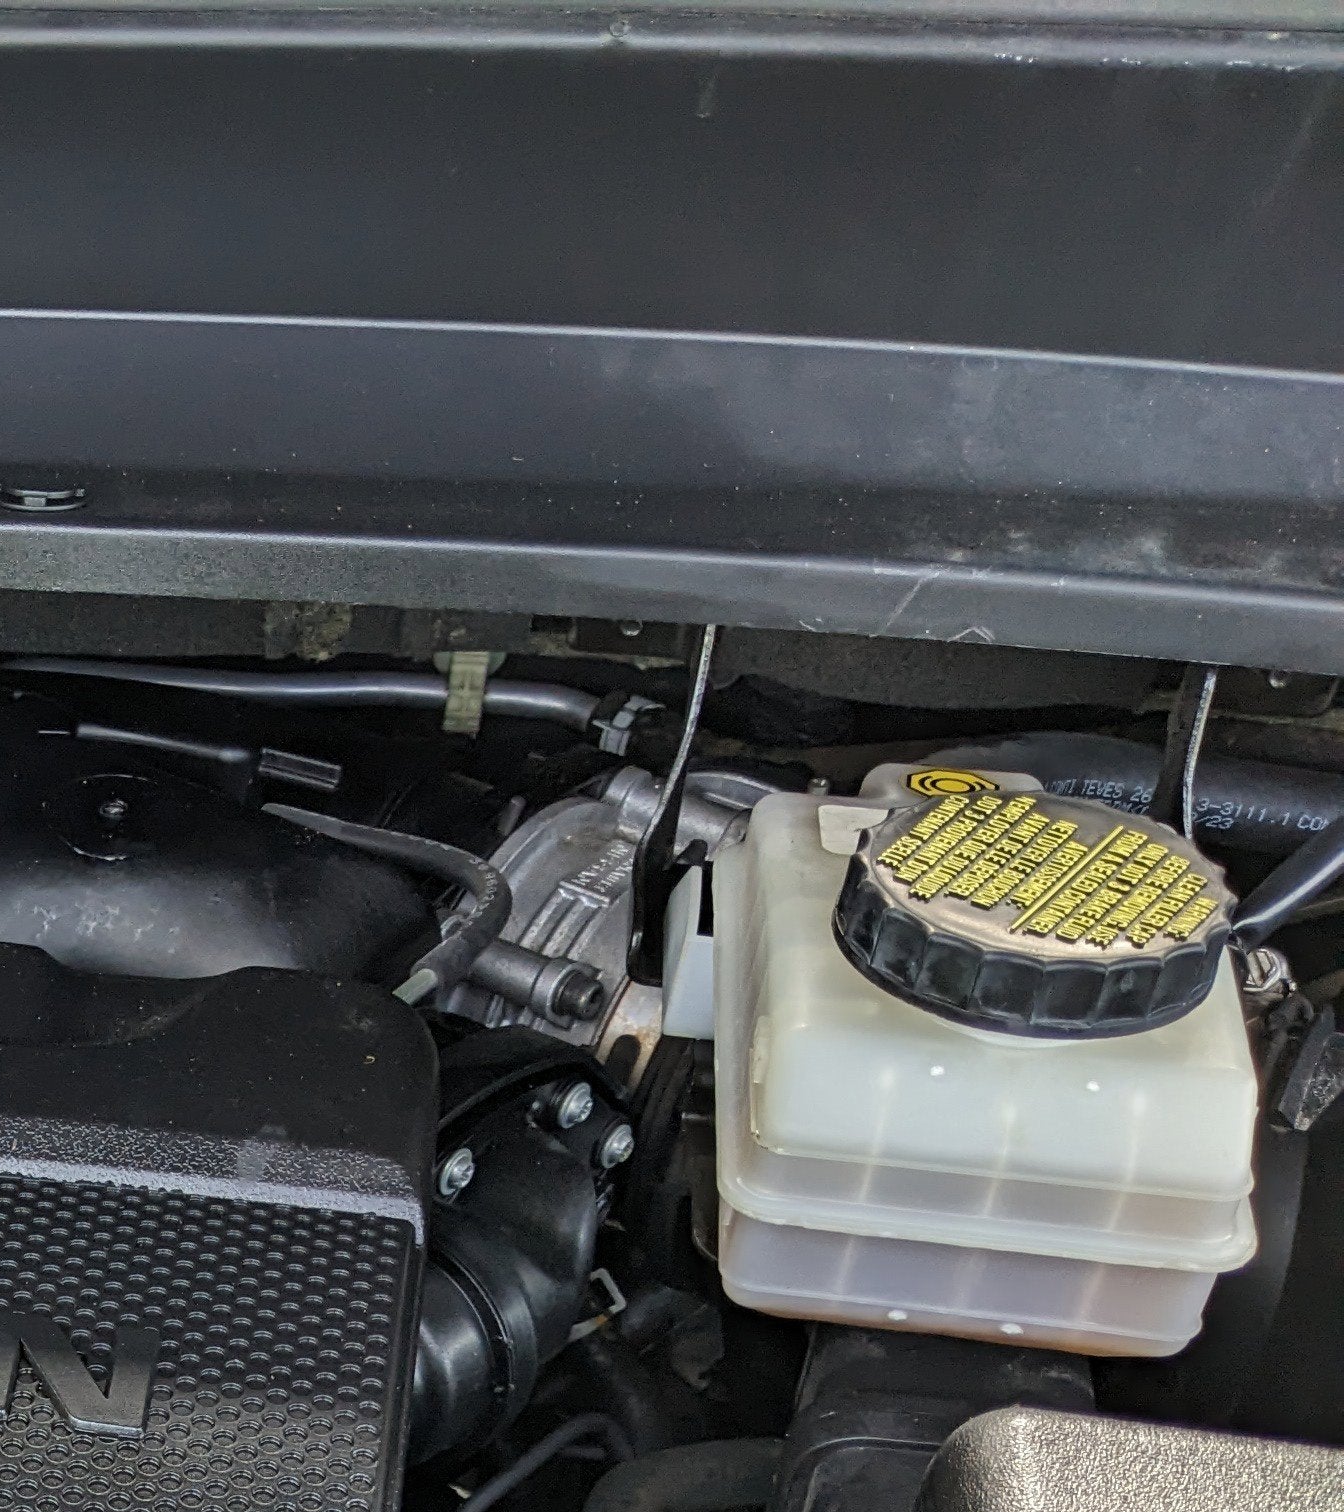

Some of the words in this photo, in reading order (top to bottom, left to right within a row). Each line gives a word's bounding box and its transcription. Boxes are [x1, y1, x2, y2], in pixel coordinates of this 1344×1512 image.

[1081, 779, 1125, 799] TEVES
[907, 793, 970, 840] CONTENANT
[963, 809, 986, 820] 3
[971, 794, 1003, 814] DOT
[1007, 812, 1051, 843] AVANT
[913, 816, 978, 865] PROVENANT
[954, 839, 987, 859] QUE
[995, 838, 1023, 854] DE
[1020, 819, 1078, 862] NETTOYER
[1108, 830, 1148, 857] FROM
[941, 855, 970, 871] DU
[984, 849, 1011, 864] LE
[1009, 858, 1036, 873] LE
[1100, 853, 1124, 864] A
[1132, 842, 1169, 867] ONLY
[909, 866, 957, 898] LIQUIDE
[1070, 859, 1118, 893] SEALED
[1114, 862, 1149, 884] DOT
[1144, 855, 1191, 888] BEFORE
[971, 868, 1025, 907] BOUCHON
[1106, 880, 1131, 892] 3
[1166, 873, 1208, 902] CLEAN
[1077, 888, 1123, 919] BRAKE
[1141, 897, 1183, 927] FILLER
[1054, 913, 1096, 940] FLUID
[1086, 924, 1120, 945] USE
[1123, 923, 1157, 943] CAP
